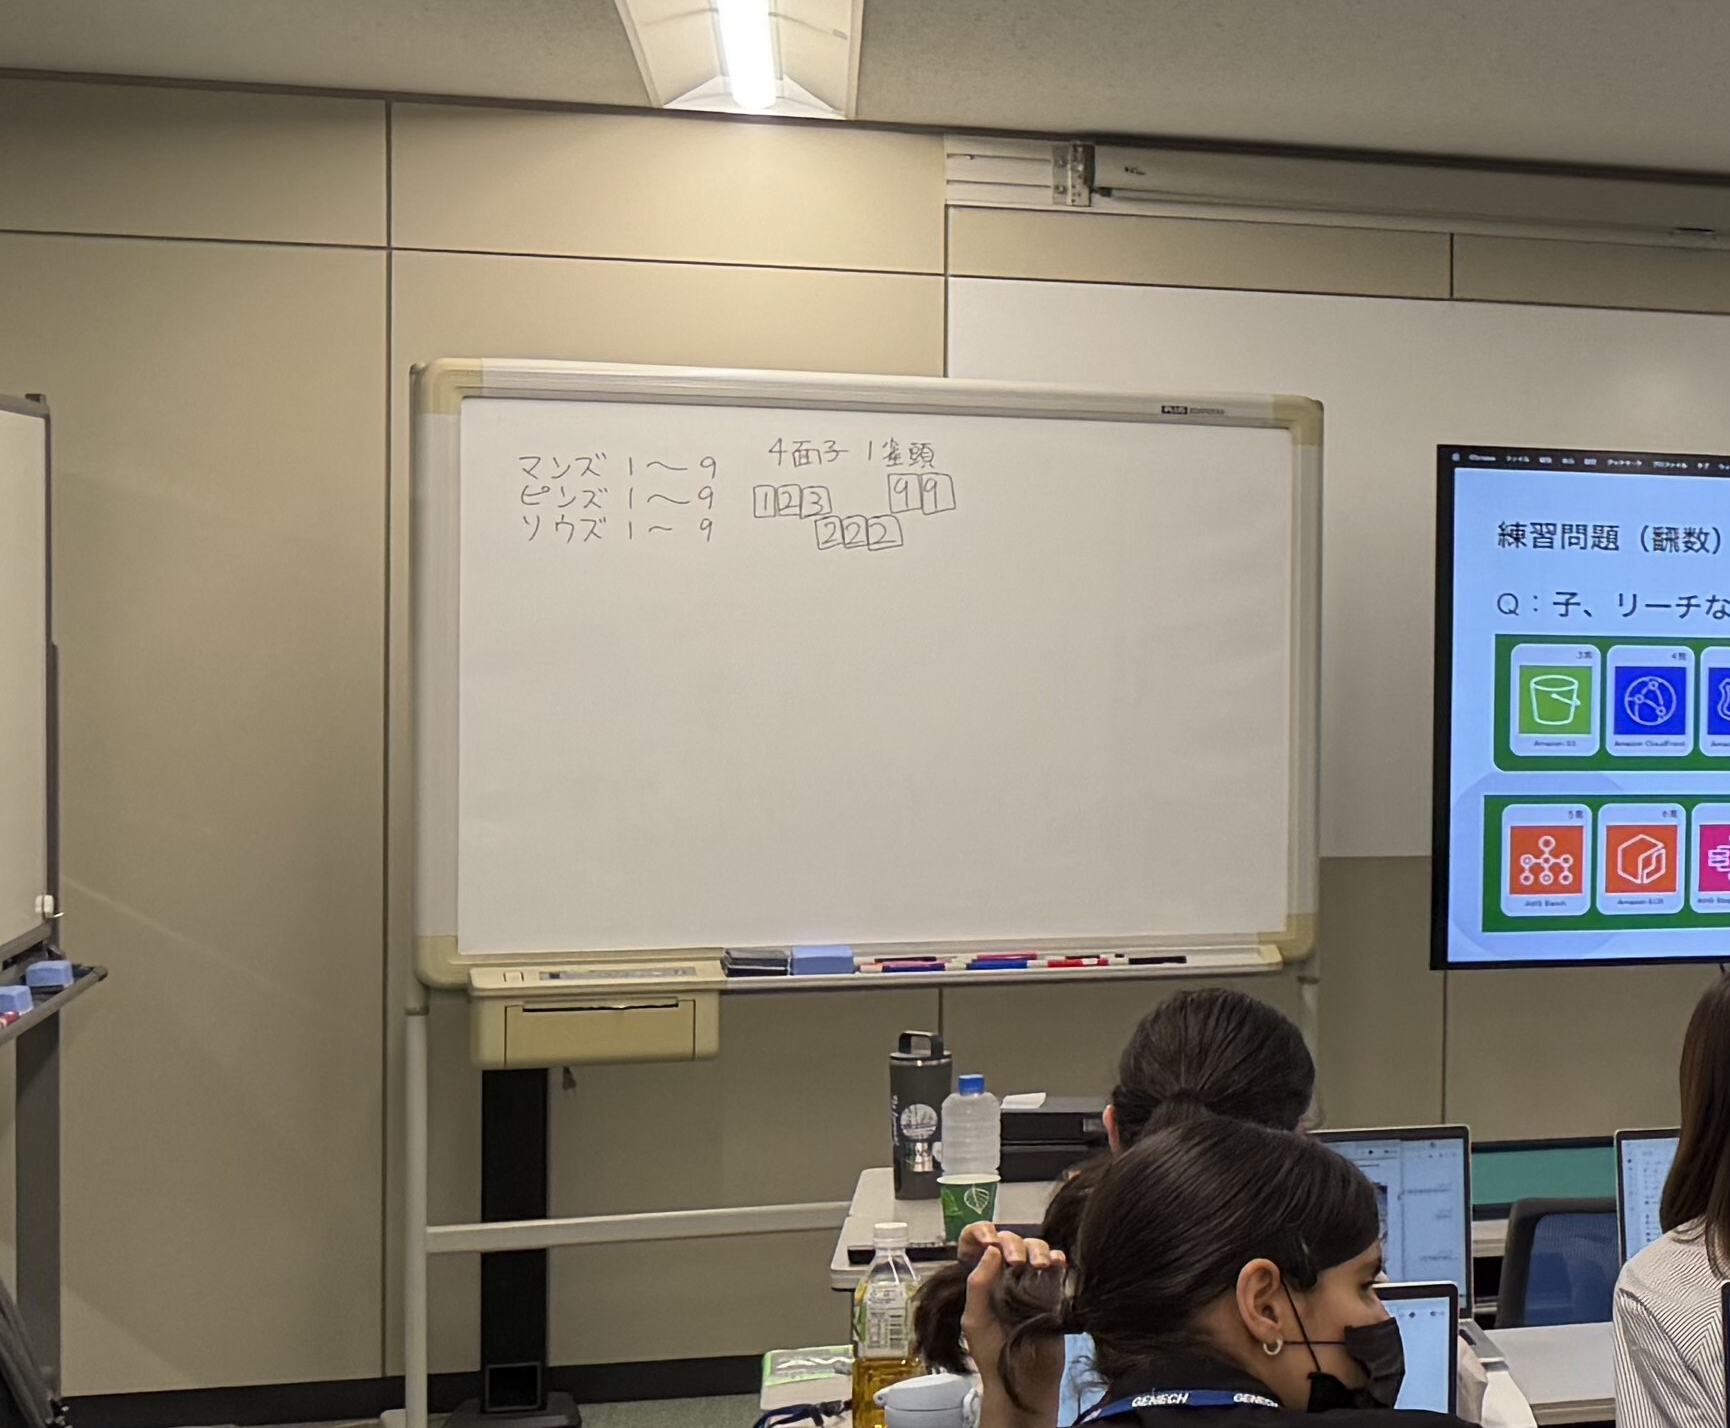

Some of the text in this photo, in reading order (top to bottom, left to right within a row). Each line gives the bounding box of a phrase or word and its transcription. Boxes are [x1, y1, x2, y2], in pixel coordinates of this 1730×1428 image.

[518, 452, 608, 480] マンズ
[520, 484, 609, 509] ピンズ
[522, 514, 608, 544] ソウズ
